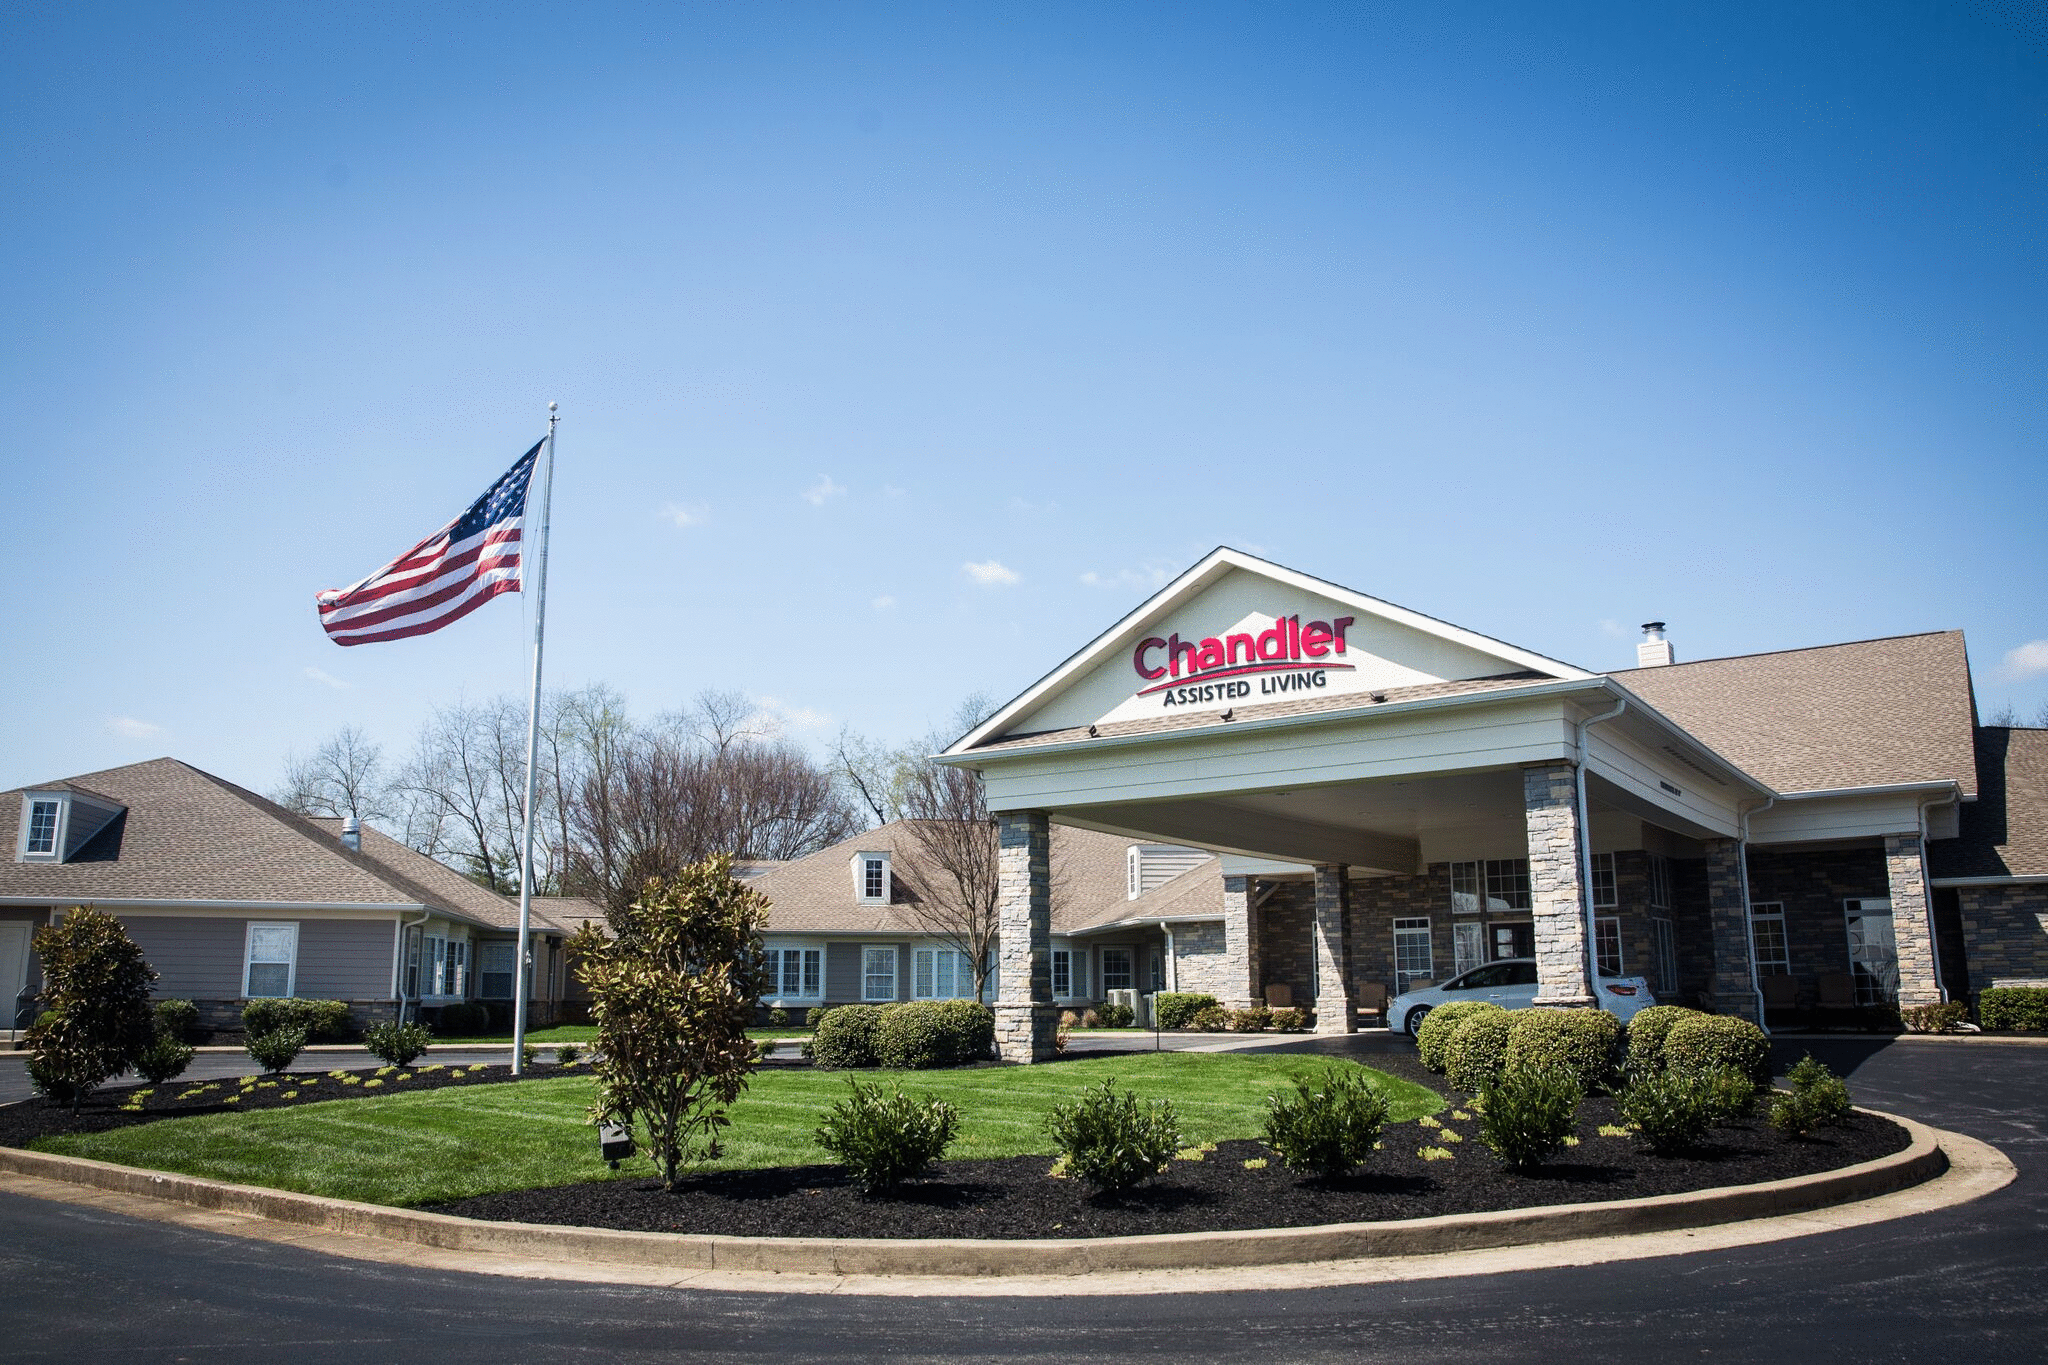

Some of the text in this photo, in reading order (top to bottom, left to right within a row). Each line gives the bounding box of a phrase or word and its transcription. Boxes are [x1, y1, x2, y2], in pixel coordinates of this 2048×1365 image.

[1133, 614, 1355, 680] Chandler
[1163, 670, 1326, 706] ASSISTED LIVING
